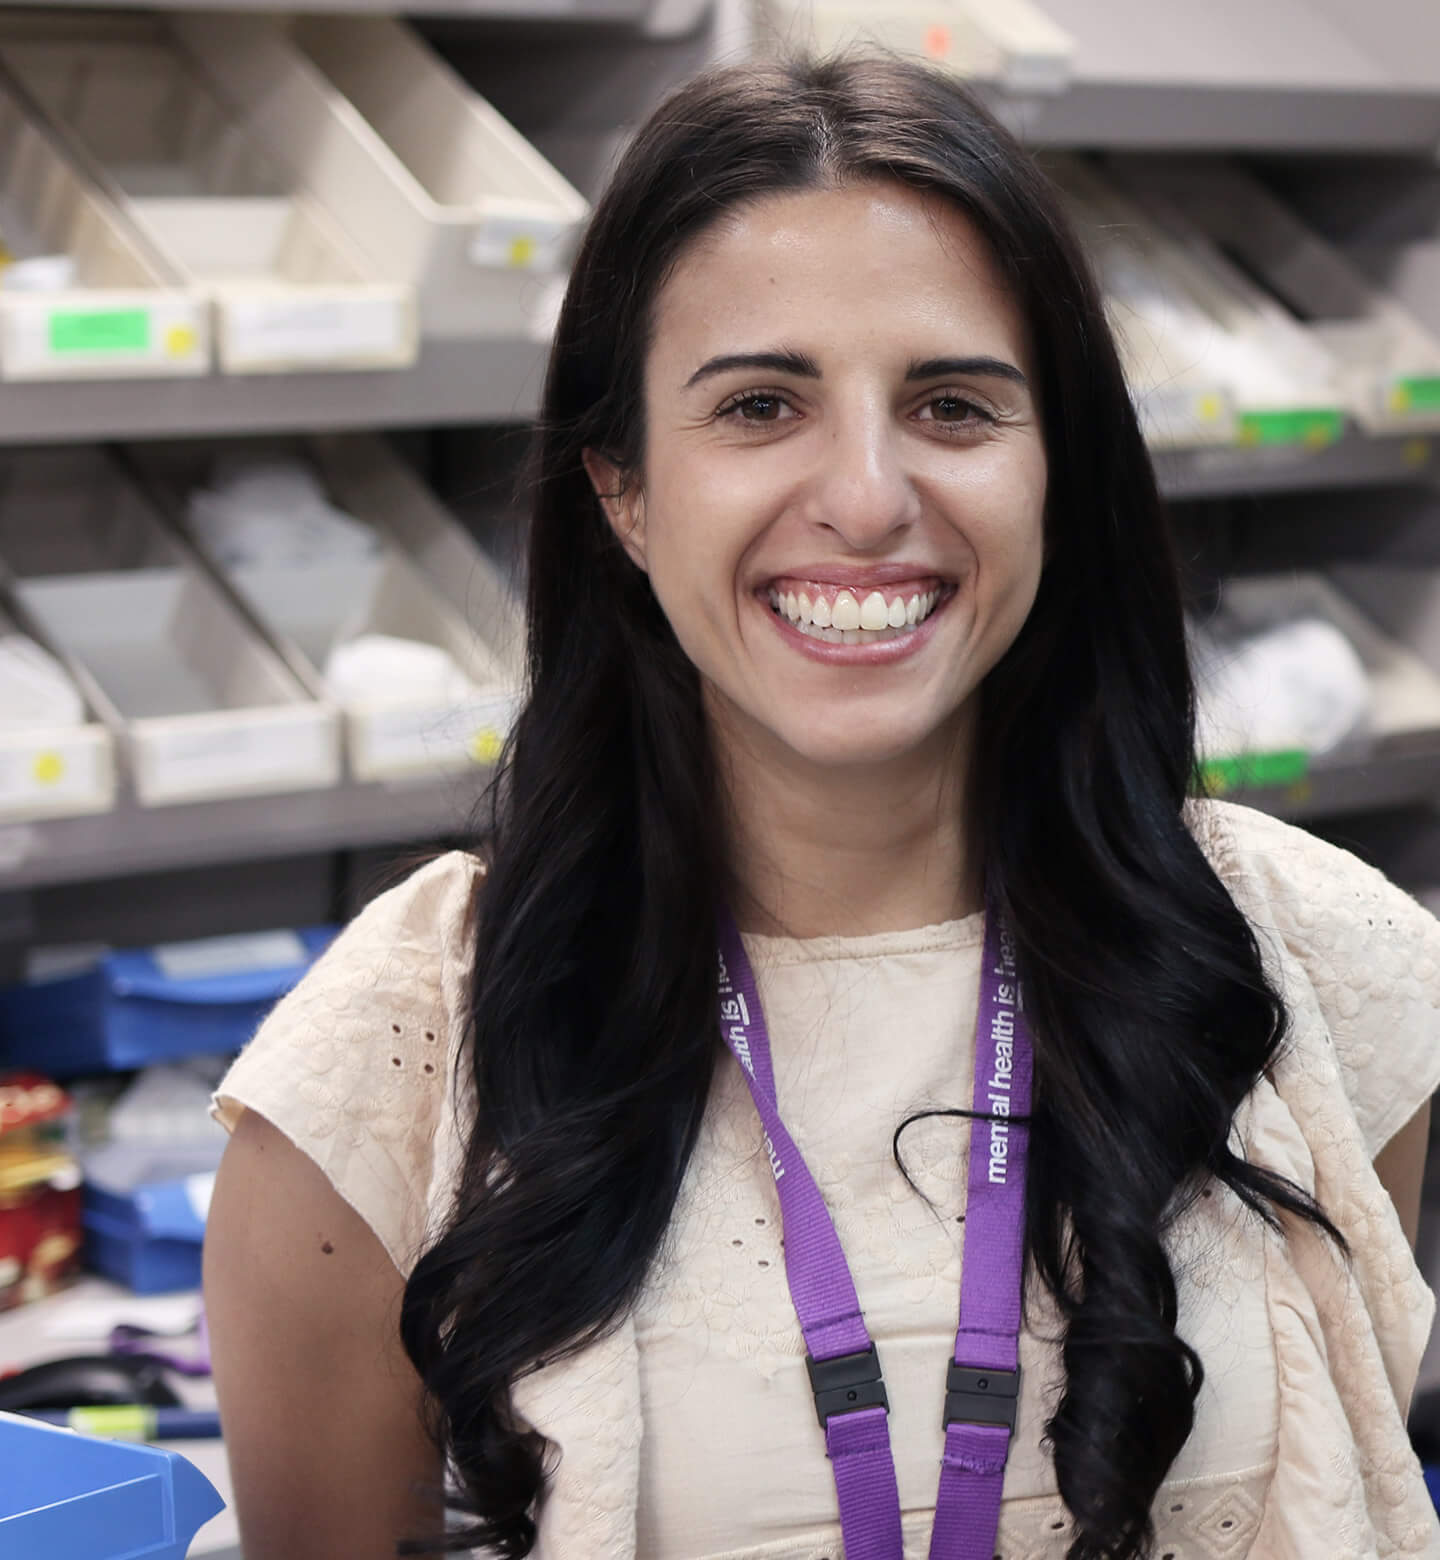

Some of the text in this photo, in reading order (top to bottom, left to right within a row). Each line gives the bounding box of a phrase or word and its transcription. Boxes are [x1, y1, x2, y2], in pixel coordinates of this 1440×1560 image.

[993, 983, 1015, 1005] is
[721, 999, 741, 1021] is
[988, 1010, 1015, 1090] health
